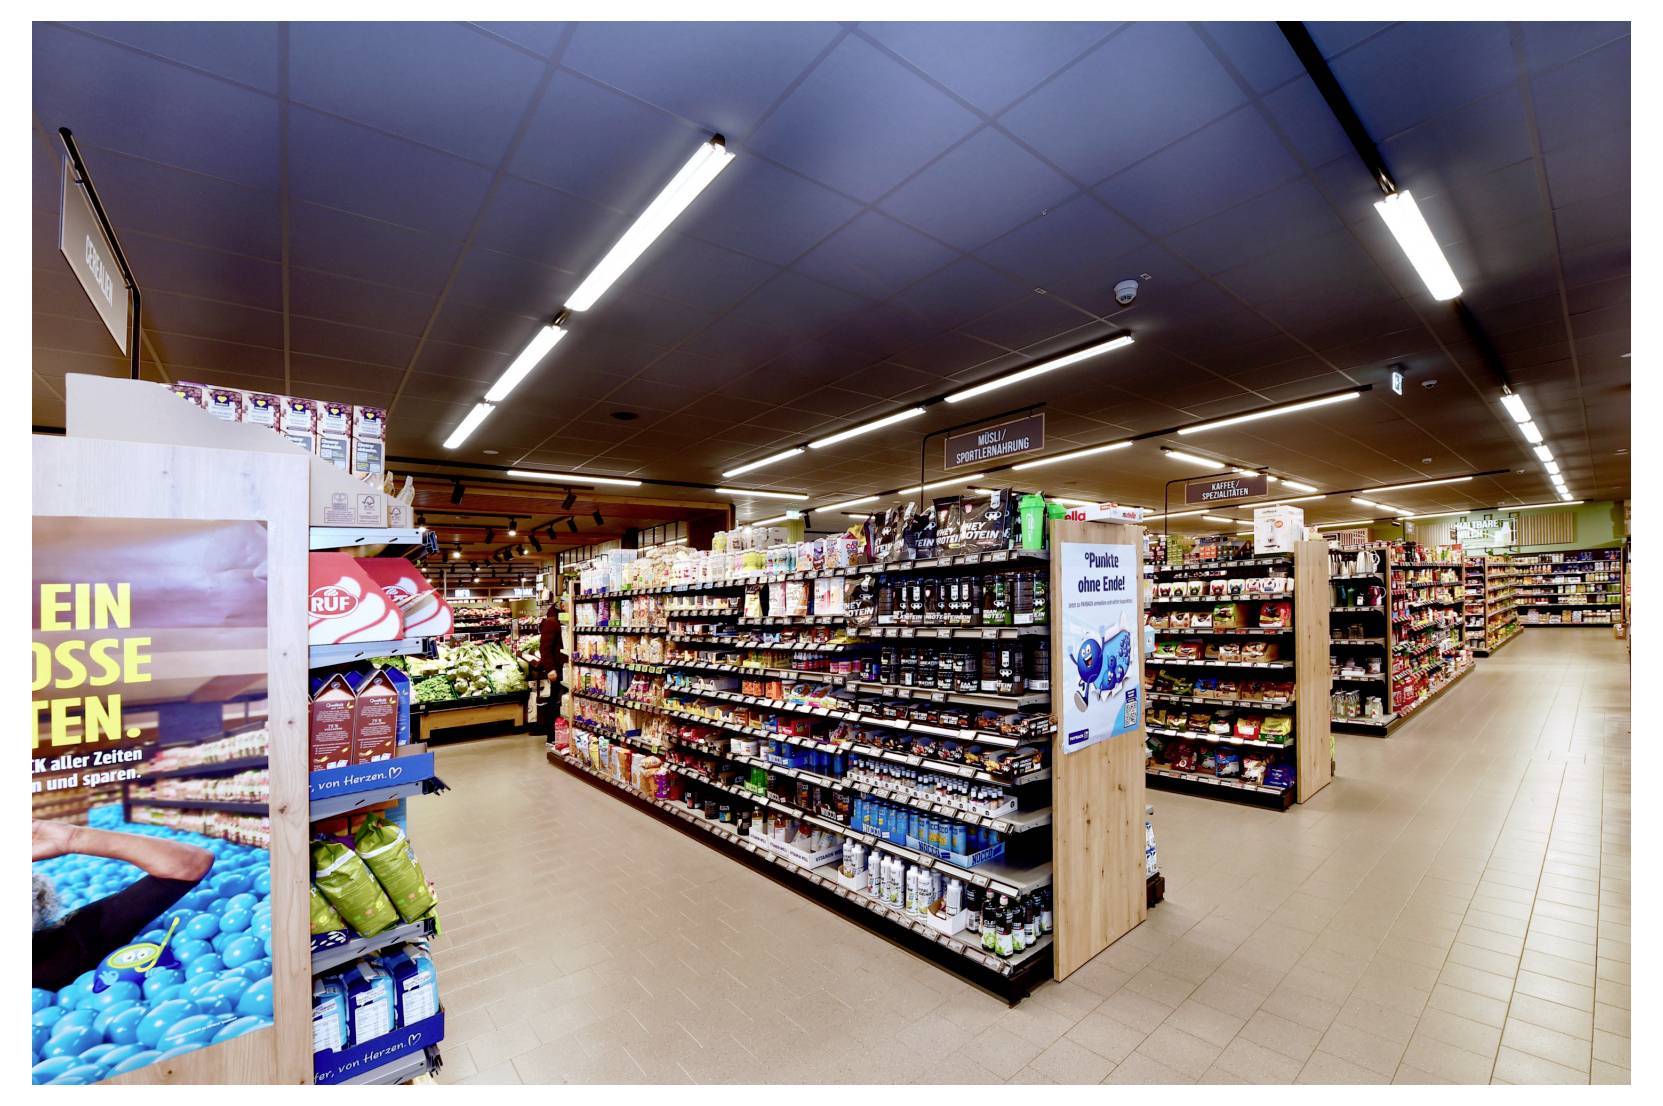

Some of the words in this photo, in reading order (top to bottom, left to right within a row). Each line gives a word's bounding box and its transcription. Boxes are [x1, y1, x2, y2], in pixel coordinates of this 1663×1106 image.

[978, 428, 1007, 446] MÜSLI/
[956, 437, 1030, 464] SPORTLERNAHRUNG
[1202, 487, 1249, 500] SPEZIALITÄTEN
[1211, 480, 1240, 491] KAFFEE/
[1078, 576, 1100, 593] ohne
[1103, 576, 1125, 592] Ende!
[41, 582, 131, 632] EIN
[51, 754, 90, 771] aller
[93, 749, 143, 766] Zeiten
[47, 773, 78, 791] und
[82, 767, 142, 789] sparen.
[319, 779, 340, 791] von
[344, 771, 387, 786] Herzen.
[339, 1060, 360, 1073] von
[363, 1042, 407, 1064] Herzen.
